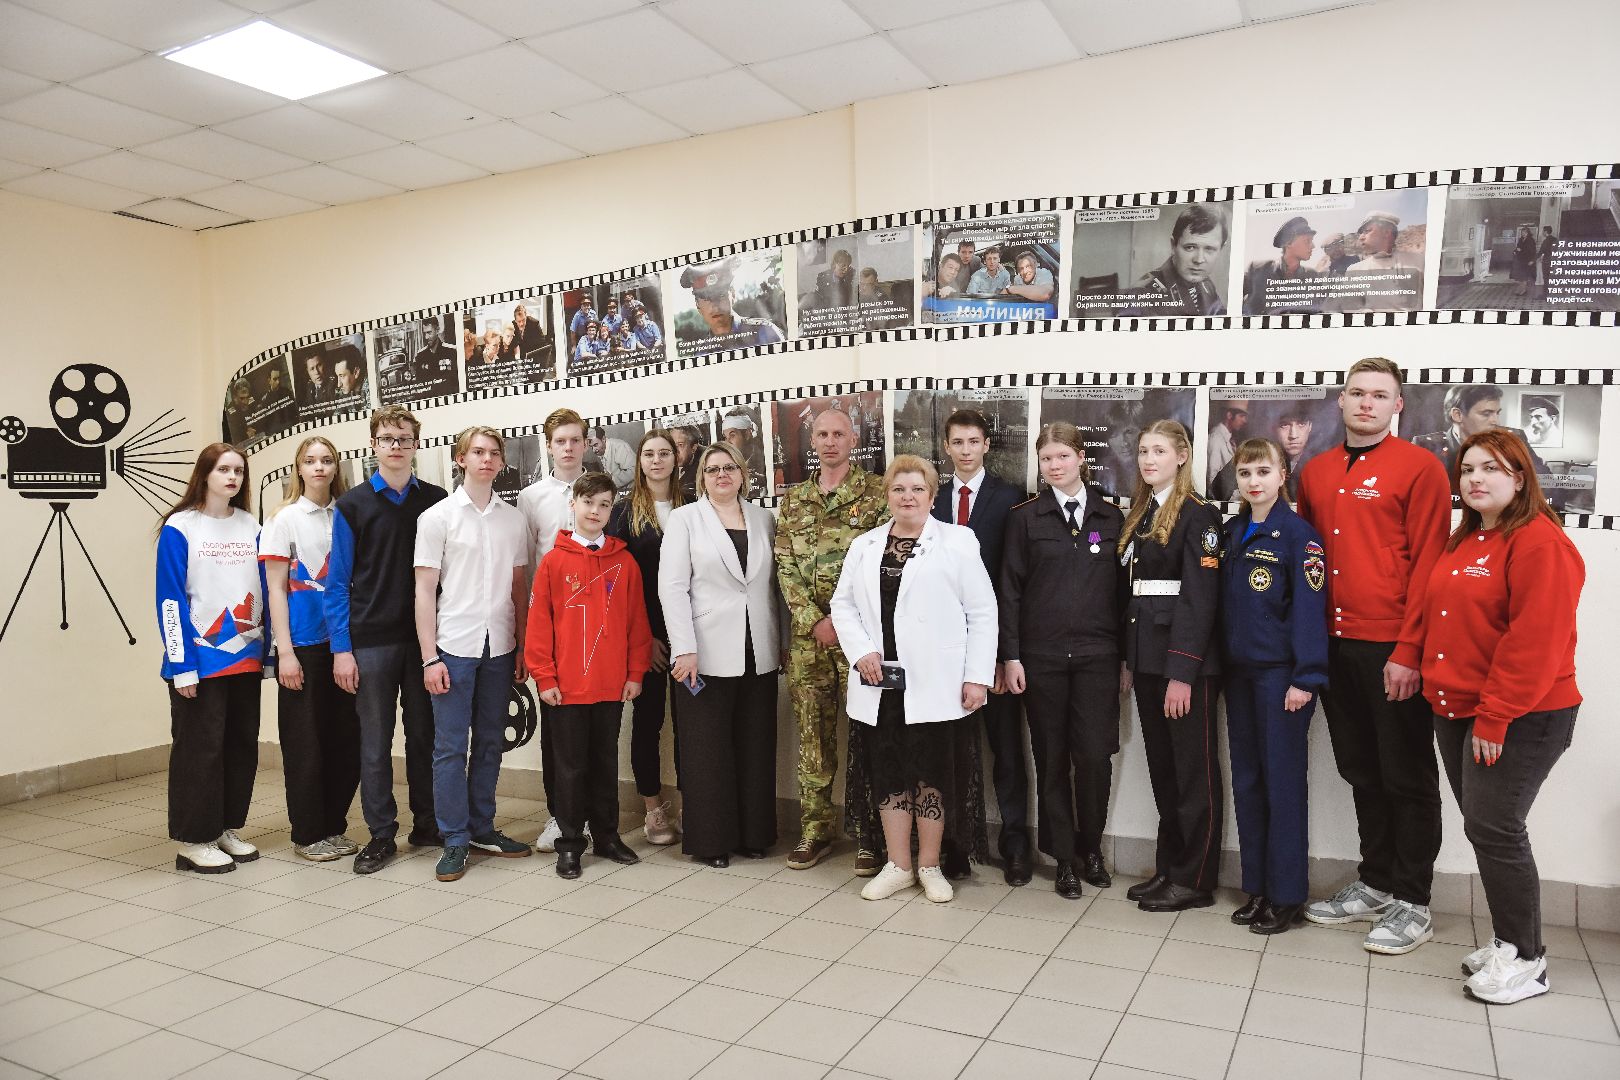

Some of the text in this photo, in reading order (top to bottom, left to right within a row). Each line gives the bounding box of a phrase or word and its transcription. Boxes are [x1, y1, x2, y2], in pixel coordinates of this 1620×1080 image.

[1558, 240, 1566, 248] Я
[1551, 250, 1607, 259] мужчинами
[1554, 267, 1563, 276] Я
[1314, 276, 1349, 284] действия
[1548, 278, 1591, 286] мужчина
[1307, 283, 1371, 292] революционного
[1076, 294, 1102, 302] Просто
[1137, 292, 1164, 300] работа
[1265, 292, 1315, 300] милиционера
[1328, 291, 1366, 299] временно
[1366, 289, 1417, 297] понижаетесь
[1076, 301, 1110, 310] Охранять
[1110, 301, 1130, 309] вашу
[1162, 299, 1186, 308] покой.
[1270, 299, 1314, 308] должности!
[1546, 296, 1594, 305] придётся.
[957, 305, 1046, 321] МИЛИЦИЯ
[166, 603, 178, 656] МЫ РЯДОМ
